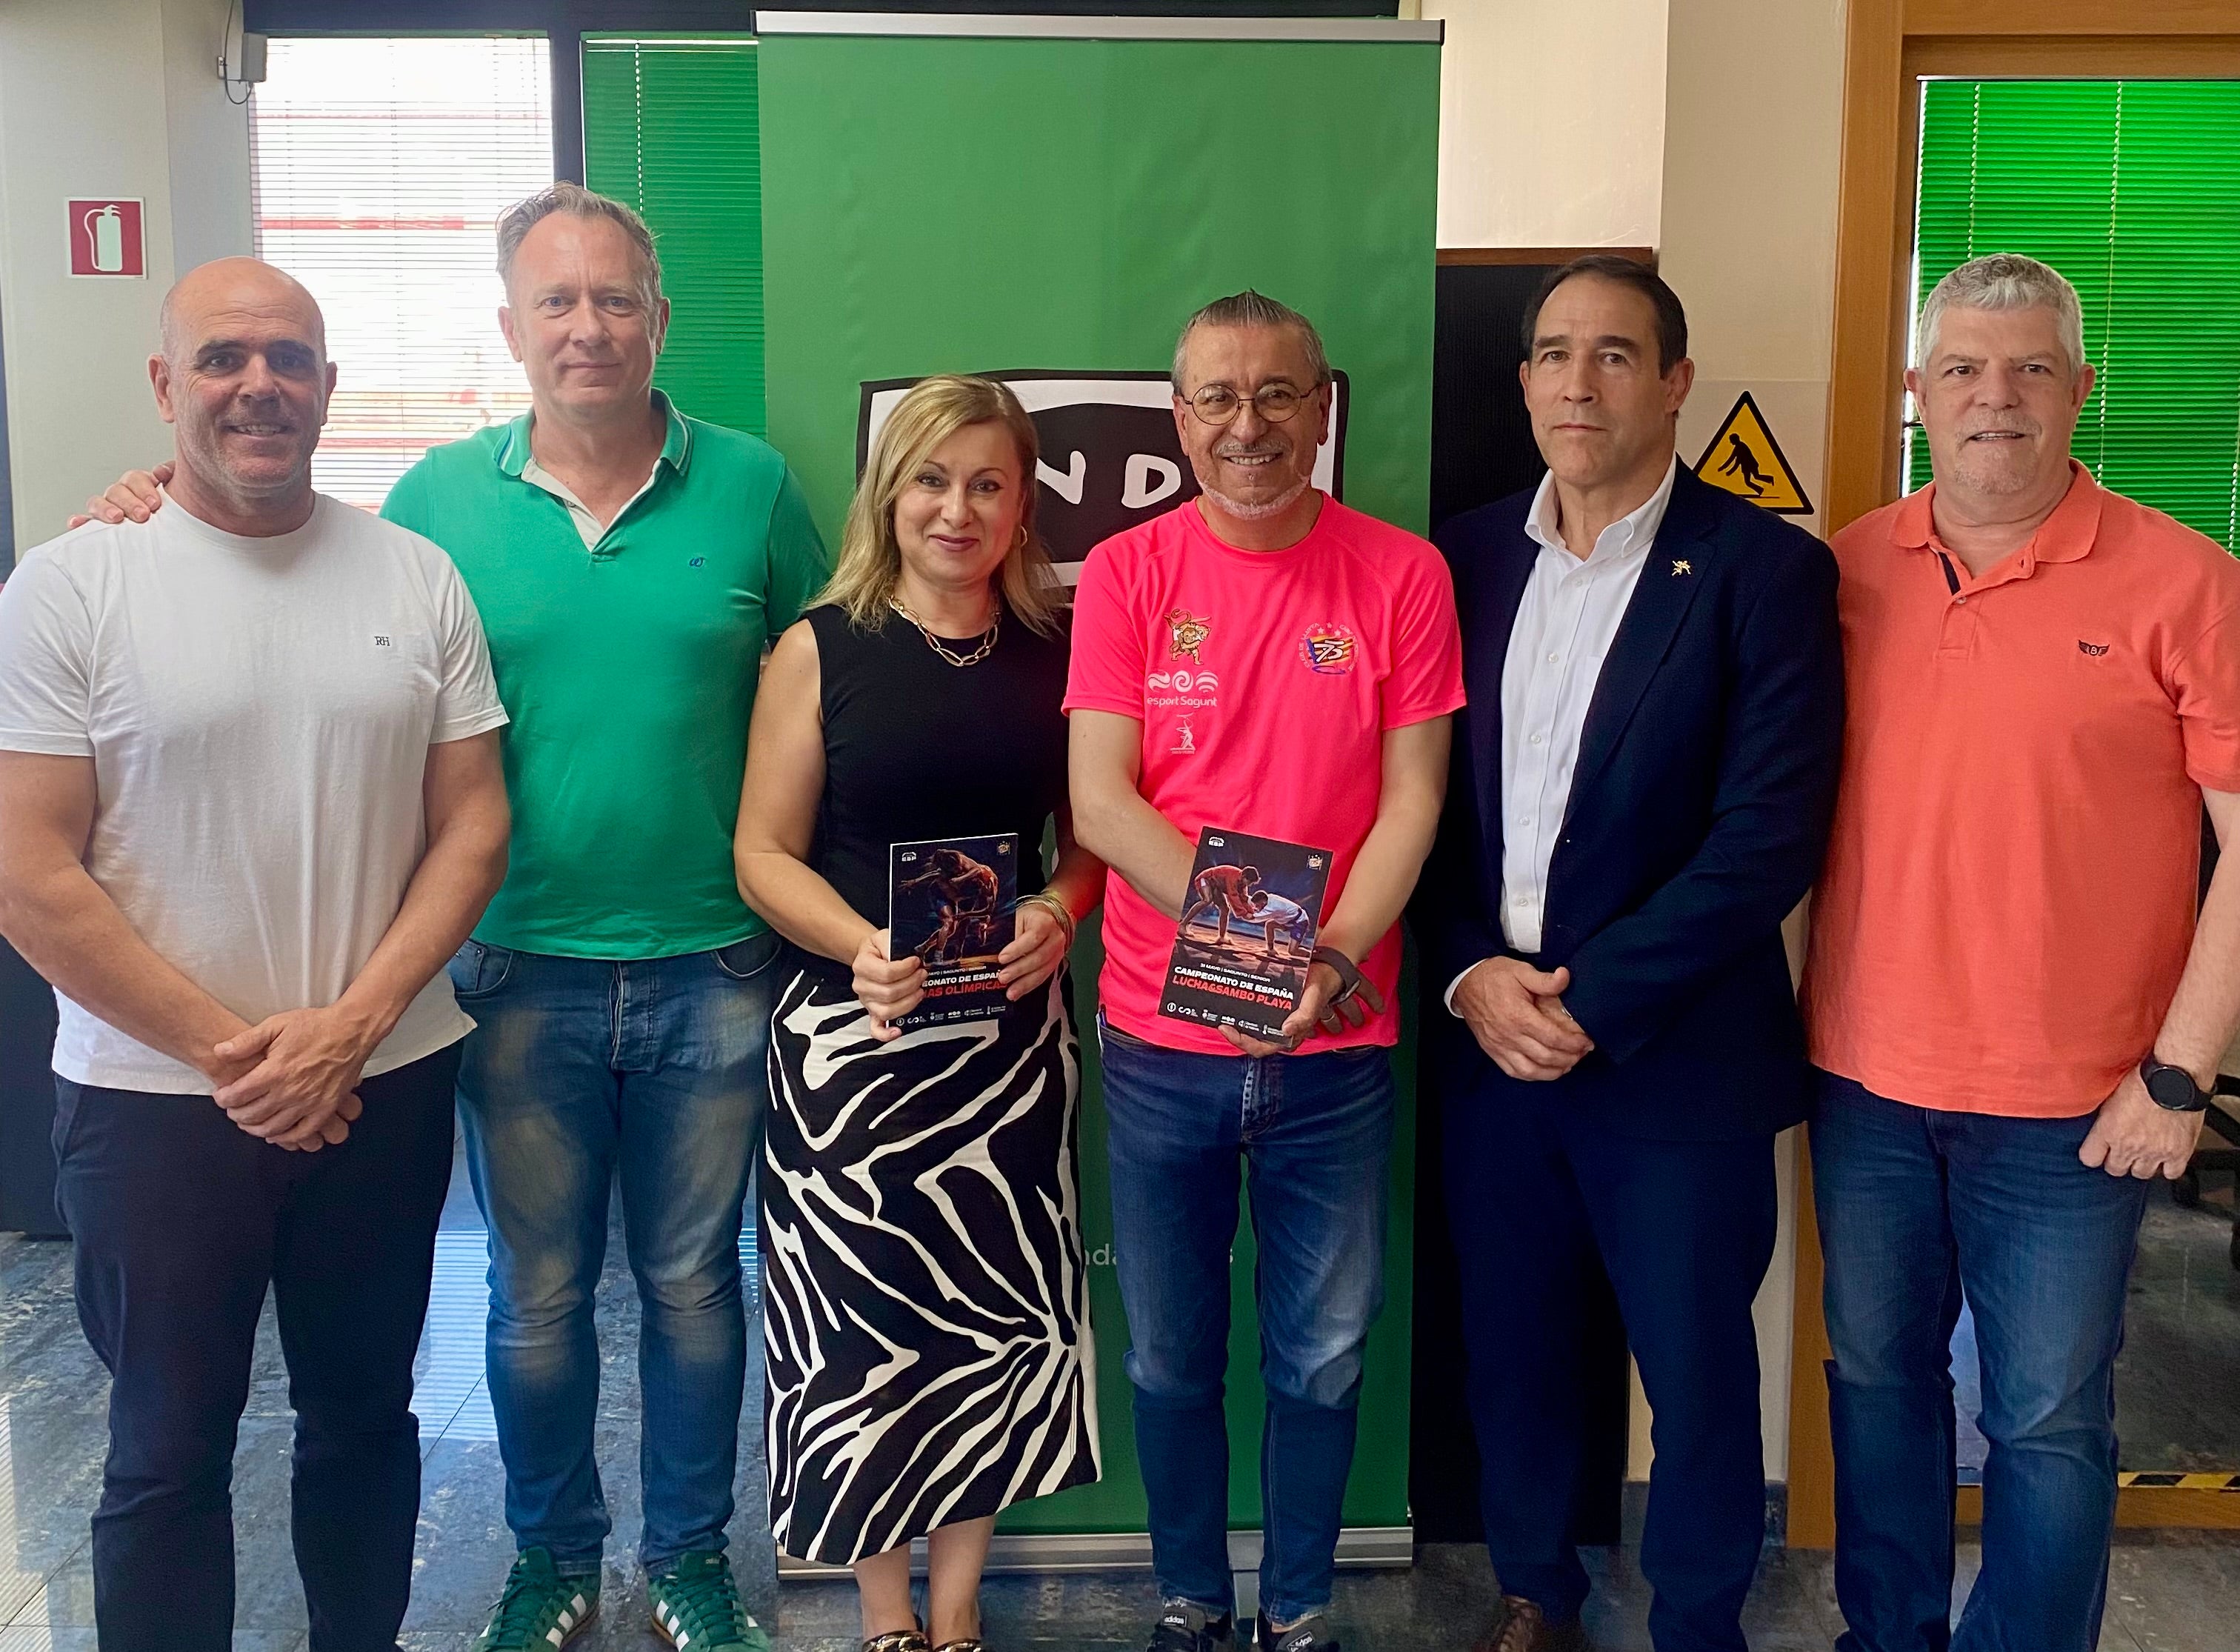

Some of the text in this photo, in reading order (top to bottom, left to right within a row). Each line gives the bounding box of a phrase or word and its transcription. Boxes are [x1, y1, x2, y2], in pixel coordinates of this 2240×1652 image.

[1035, 450, 1181, 509] ND
[374, 636, 390, 646] RH
[921, 977, 957, 987] EONATO
[958, 975, 972, 983] DE
[1172, 974, 1292, 1010] LUCHA&SAMBO PLAYA
[1174, 966, 1294, 1000] CAMPEONATO DE ESPAÑA
[1164, 1615, 1184, 1625] adidas
